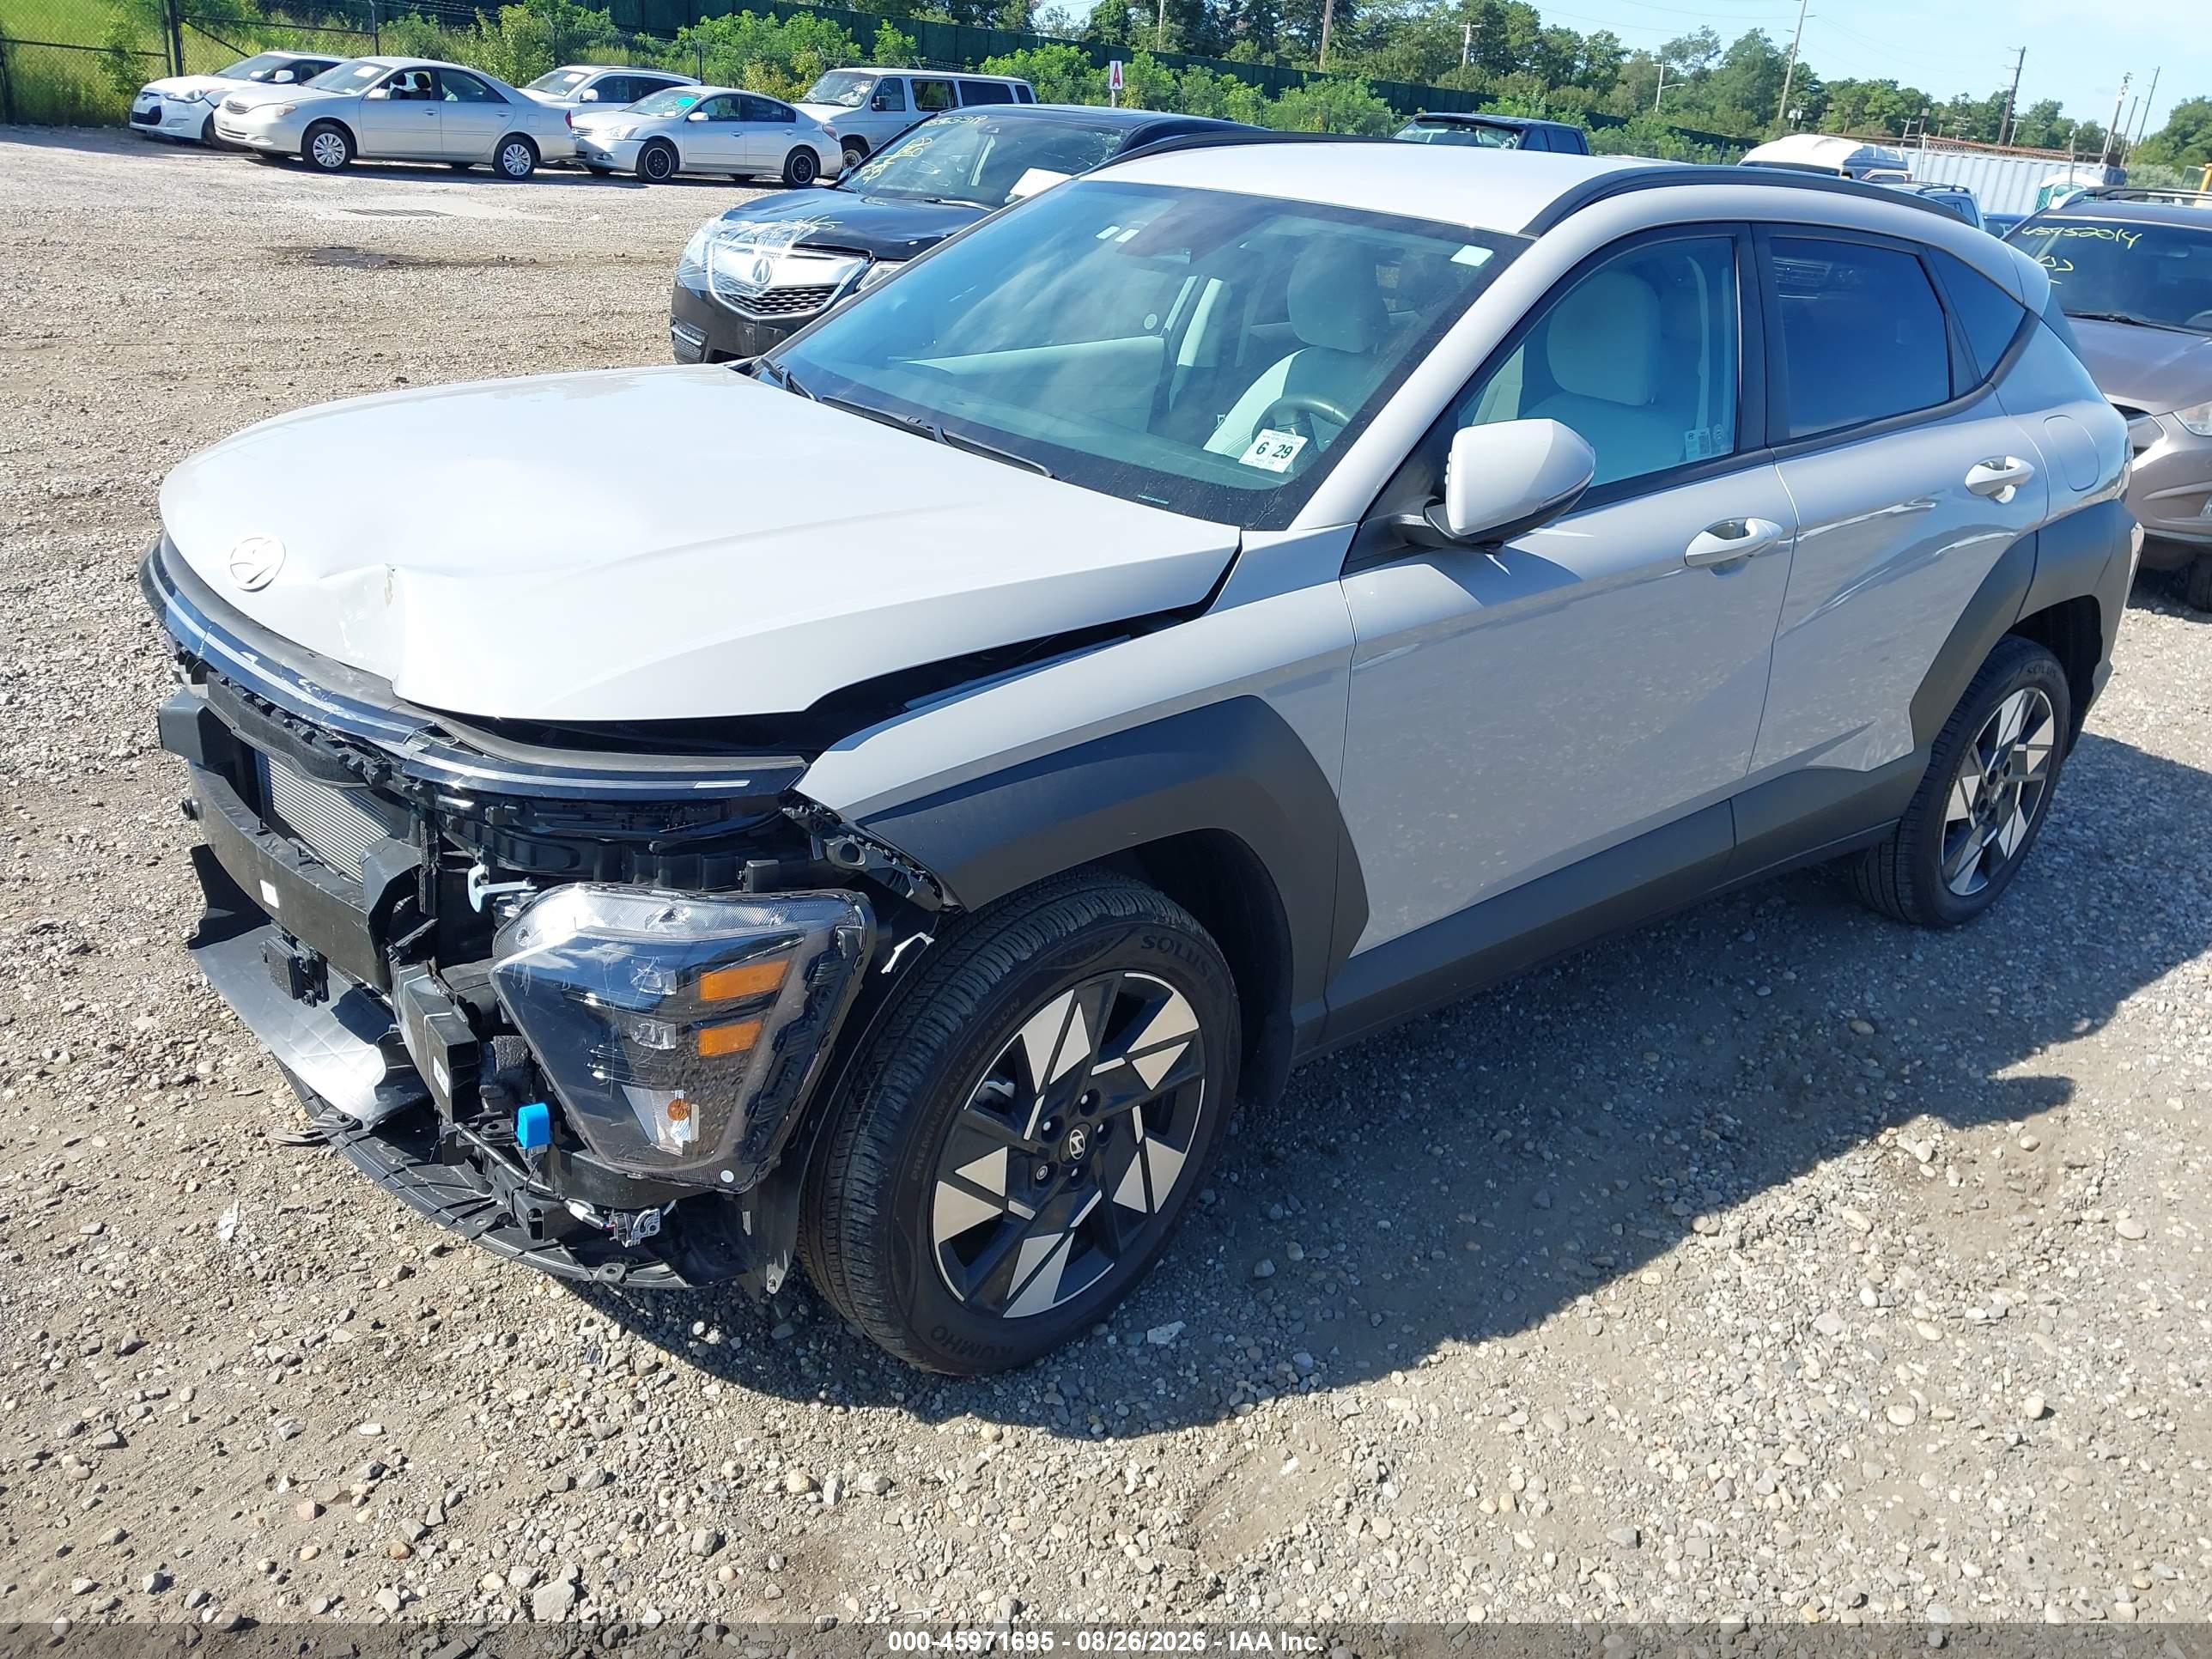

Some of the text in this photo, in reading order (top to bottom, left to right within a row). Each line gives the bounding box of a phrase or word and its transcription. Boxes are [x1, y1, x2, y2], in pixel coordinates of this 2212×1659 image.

[1112, 61, 1121, 87] A
[2021, 226, 2143, 250] 45952014
[1255, 441, 1294, 459] 6 29
[1140, 934, 1211, 978] SOLUS
[910, 1097, 948, 1181] PREMIUM
